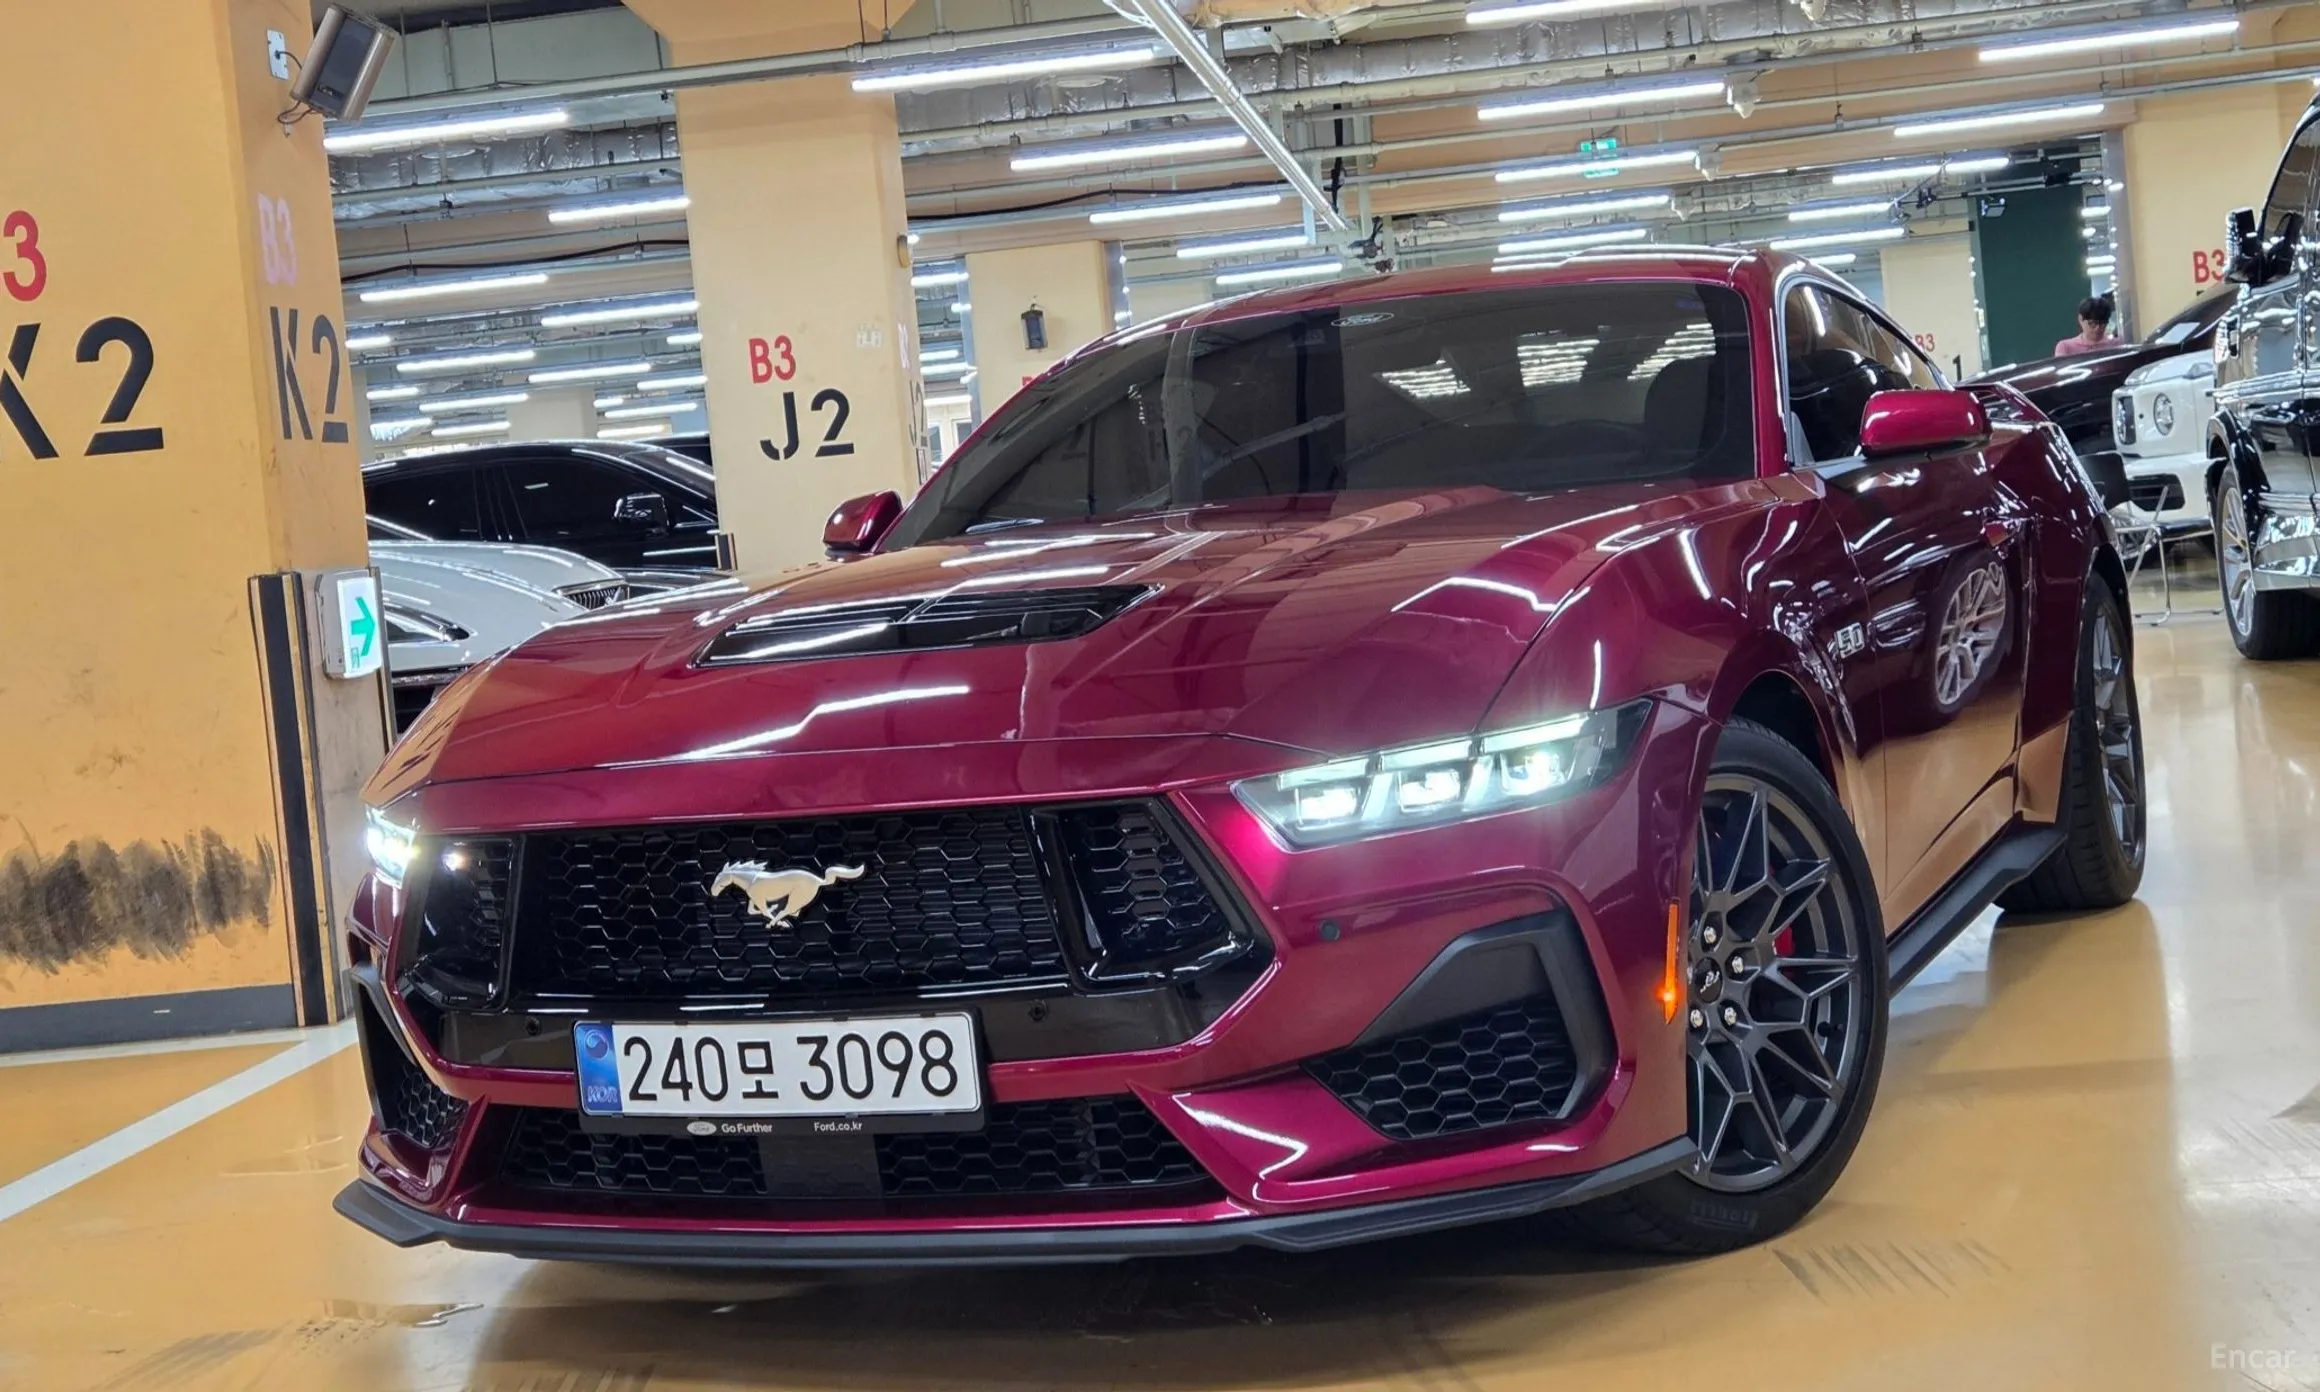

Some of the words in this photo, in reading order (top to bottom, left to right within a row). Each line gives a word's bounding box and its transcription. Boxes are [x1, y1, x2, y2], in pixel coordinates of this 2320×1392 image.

[2193, 249, 2225, 284] B3
[270, 306, 349, 443] K2
[749, 335, 796, 384] B3
[760, 388, 854, 461] J2
[624, 1035, 779, 1102] 240모
[796, 1029, 959, 1101] 3098
[587, 1086, 618, 1103] KOR
[721, 1123, 736, 1133] Go
[737, 1122, 773, 1133] Further
[814, 1121, 863, 1132] Ford.co.kr
